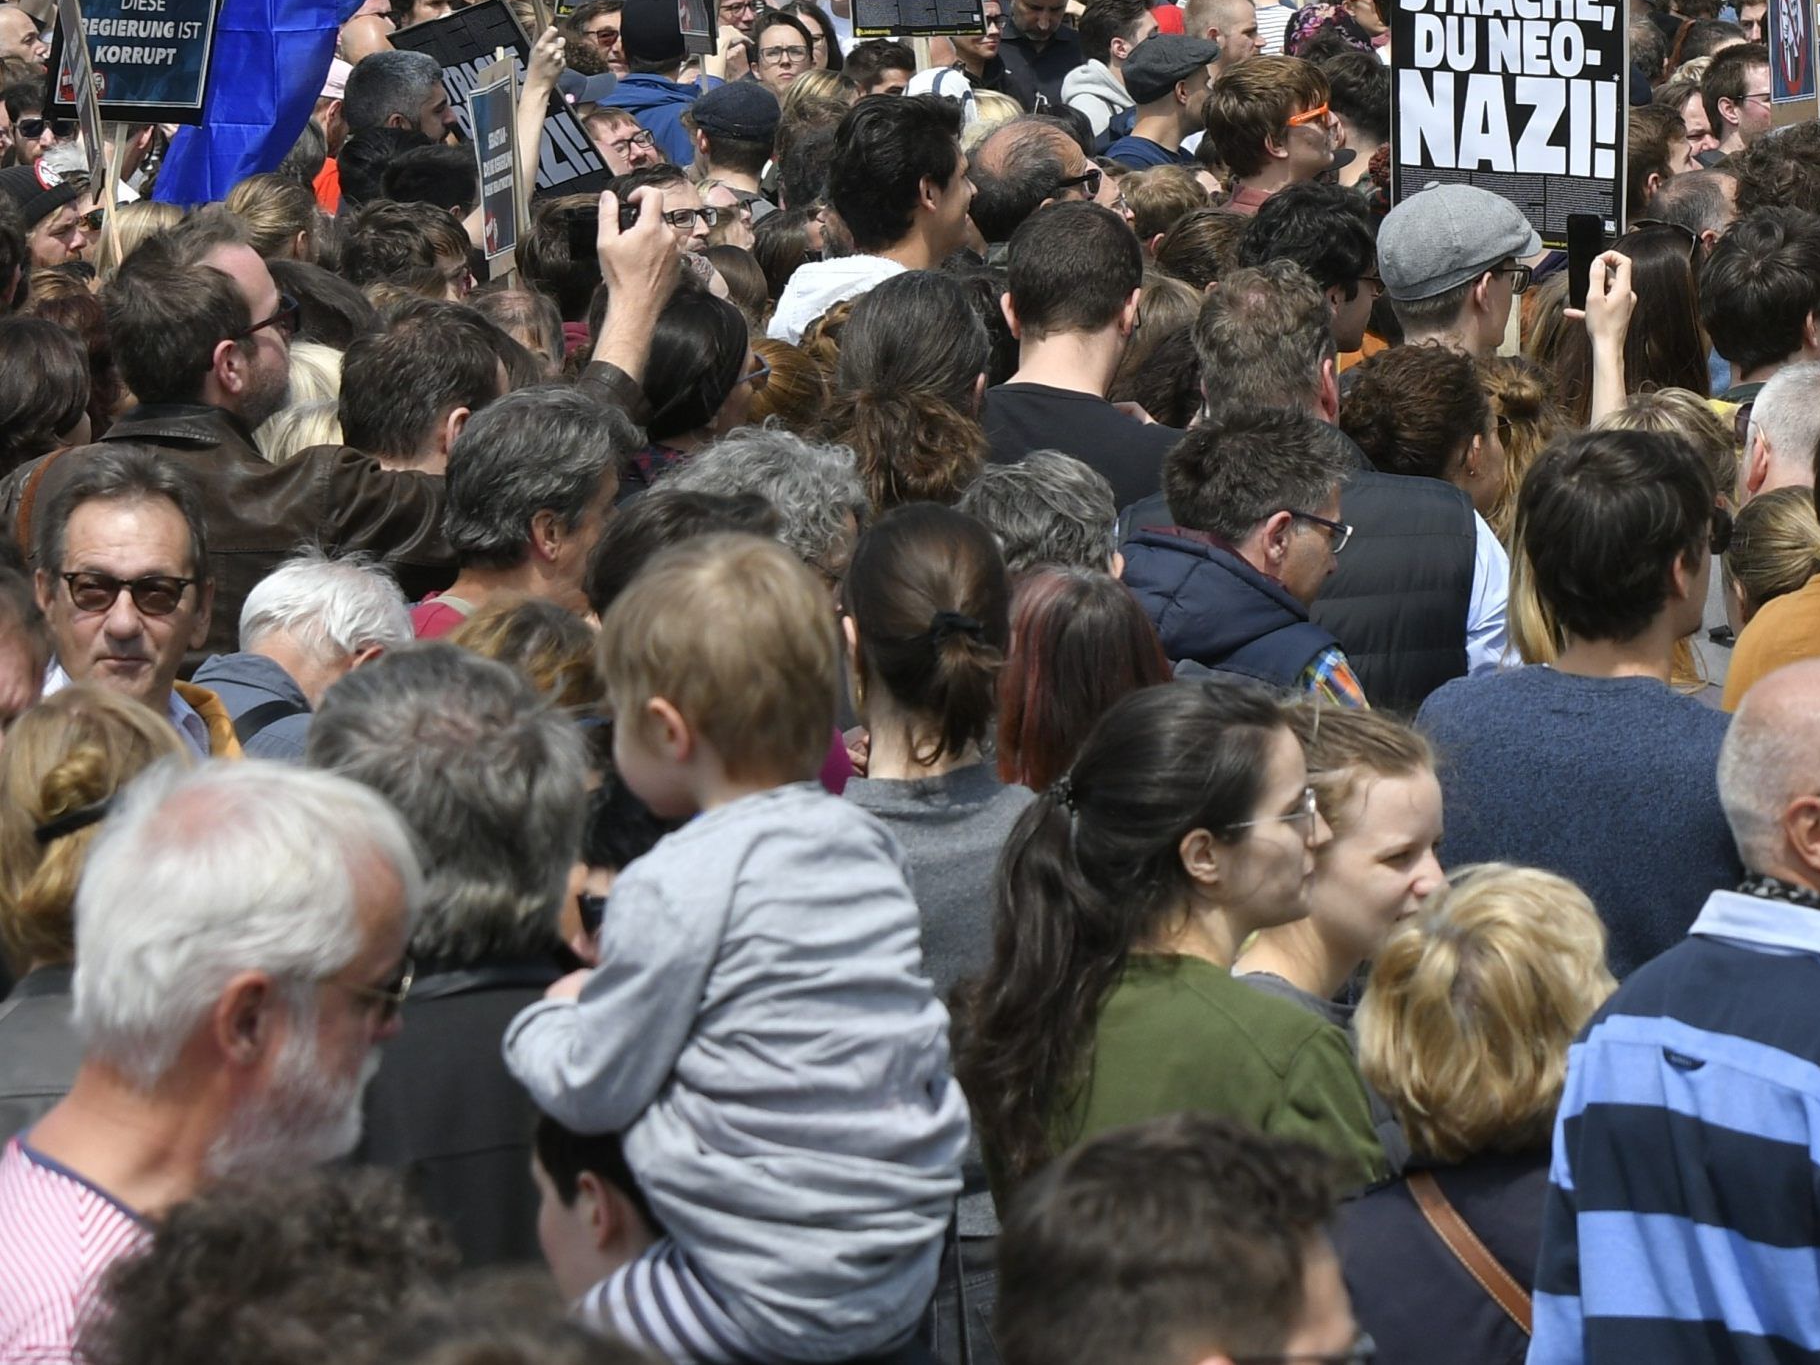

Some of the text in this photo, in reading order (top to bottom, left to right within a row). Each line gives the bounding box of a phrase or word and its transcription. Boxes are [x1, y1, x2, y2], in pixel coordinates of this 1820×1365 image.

[178, 22, 202, 39] IST
[1414, 13, 1602, 78] DU NEO-
[95, 45, 176, 65] KORRUPT
[1399, 68, 1617, 180] NAZI!
